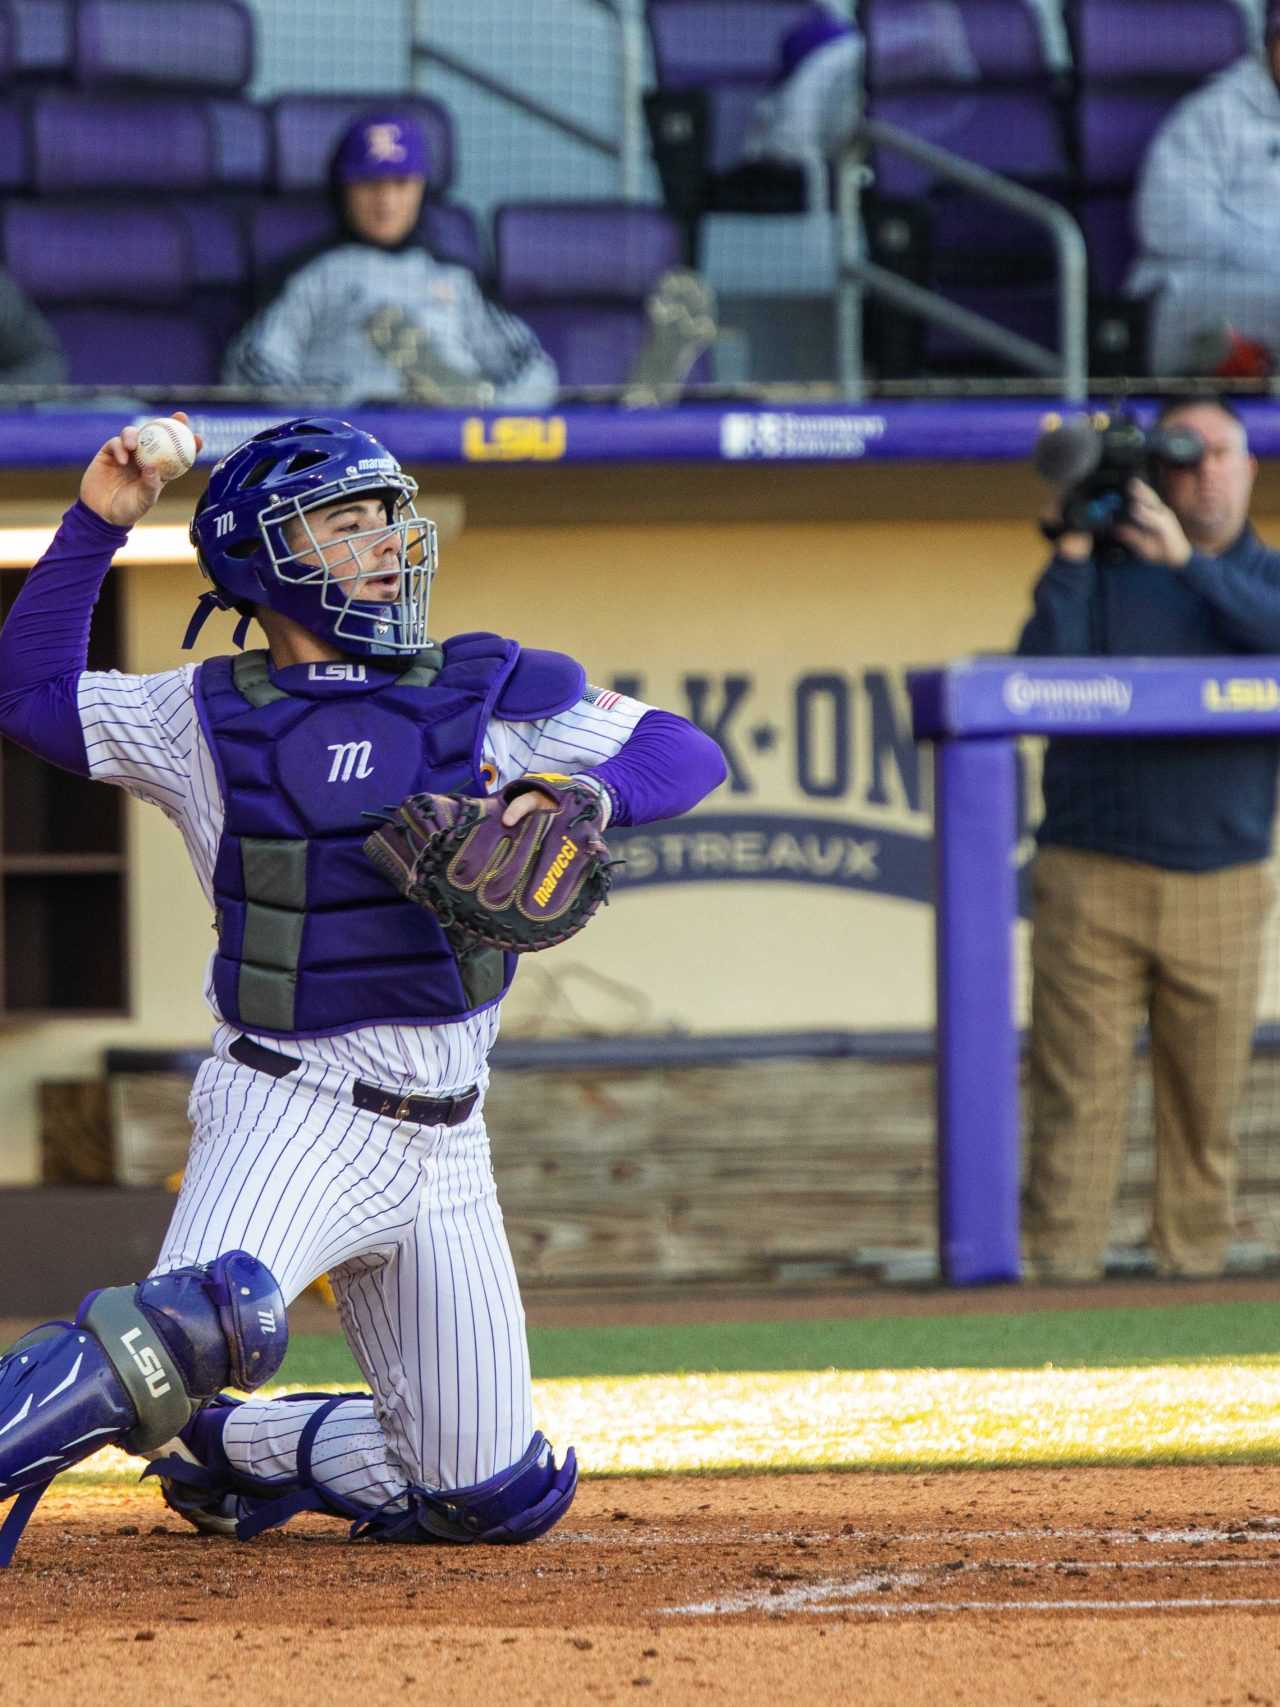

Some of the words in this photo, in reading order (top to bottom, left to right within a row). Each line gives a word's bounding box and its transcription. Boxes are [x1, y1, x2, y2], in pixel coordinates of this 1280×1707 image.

[462, 415, 567, 462] LSU
[308, 664, 366, 681] LSU
[1201, 678, 1280, 714] LSU
[533, 835, 578, 908] marucci
[120, 1327, 171, 1398] LSU
